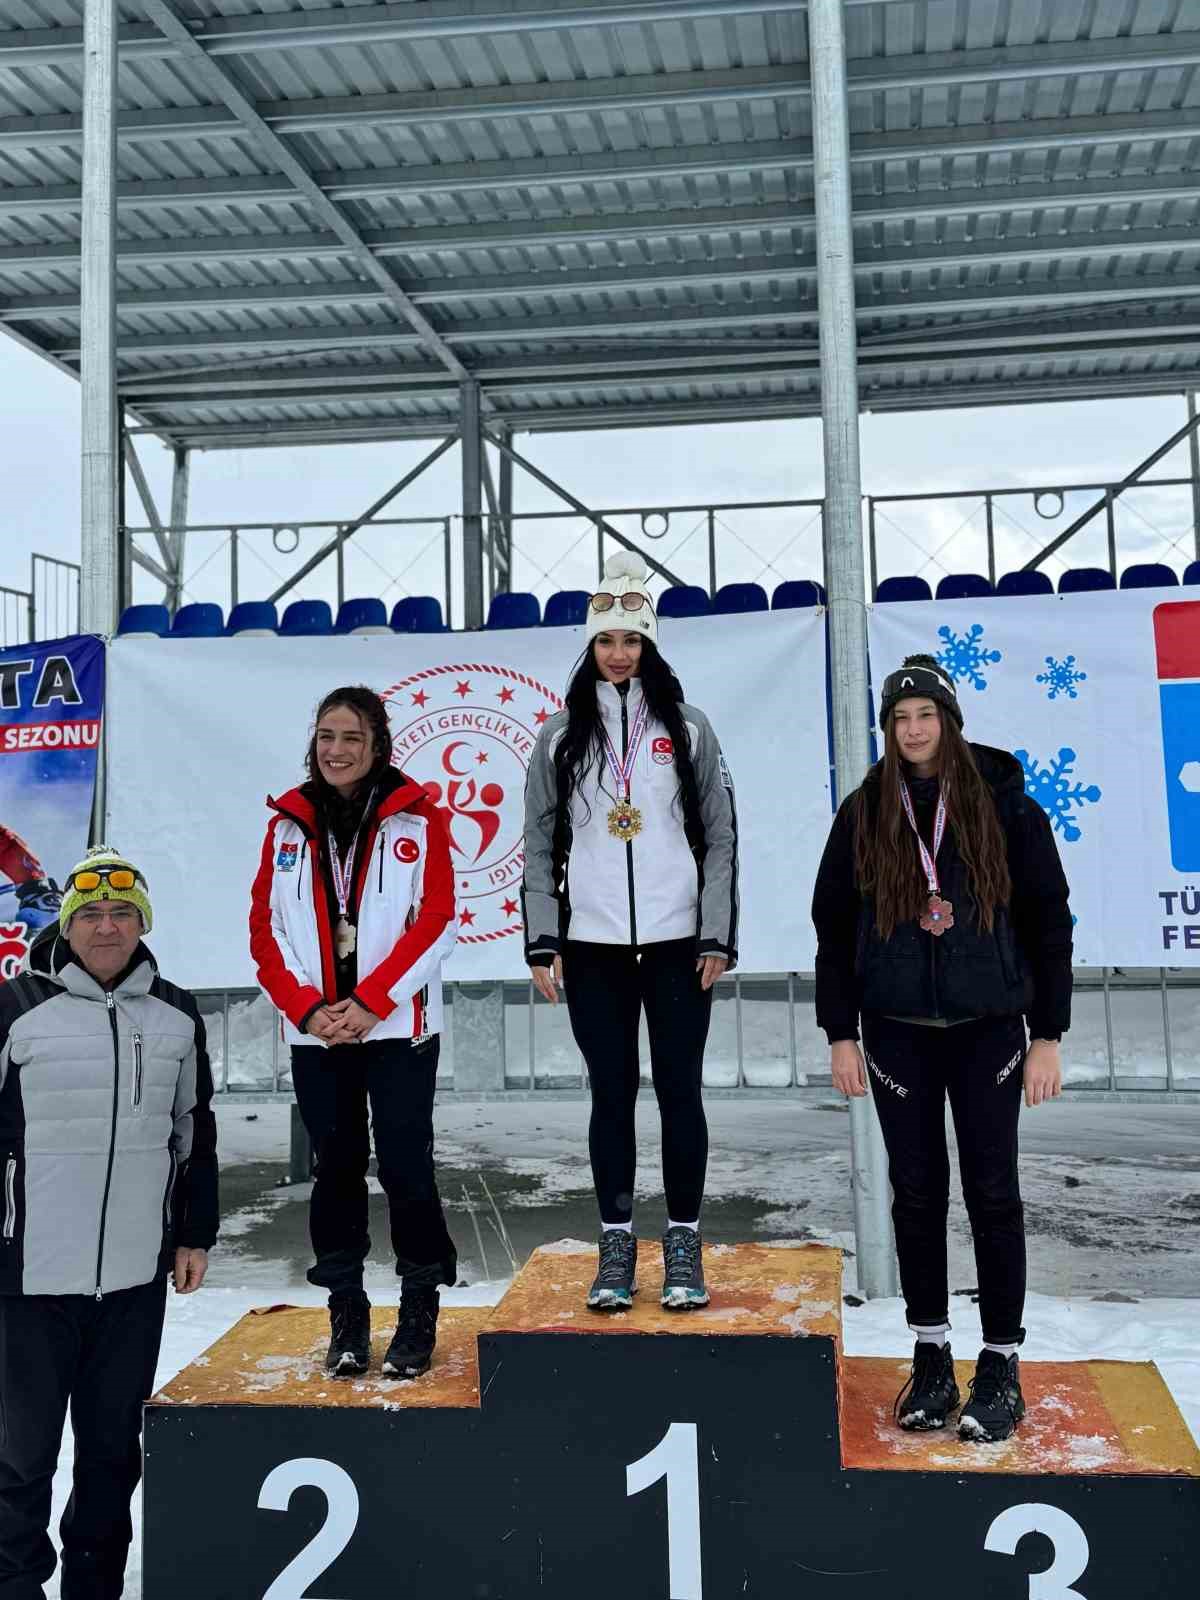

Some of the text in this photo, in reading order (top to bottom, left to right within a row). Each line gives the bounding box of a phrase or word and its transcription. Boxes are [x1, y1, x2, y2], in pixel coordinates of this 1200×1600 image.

[0, 656, 83, 709] TA
[5, 724, 98, 749] SEZONU
[438, 714, 512, 737] GENÇLİK
[513, 732, 532, 754] VE
[1158, 886, 1200, 915] TÜ
[1162, 925, 1200, 950] FE
[866, 1051, 909, 1097] ÜRKİYE
[257, 1457, 359, 1600] 2
[626, 1422, 702, 1600] 1
[984, 1503, 1090, 1600] 3
